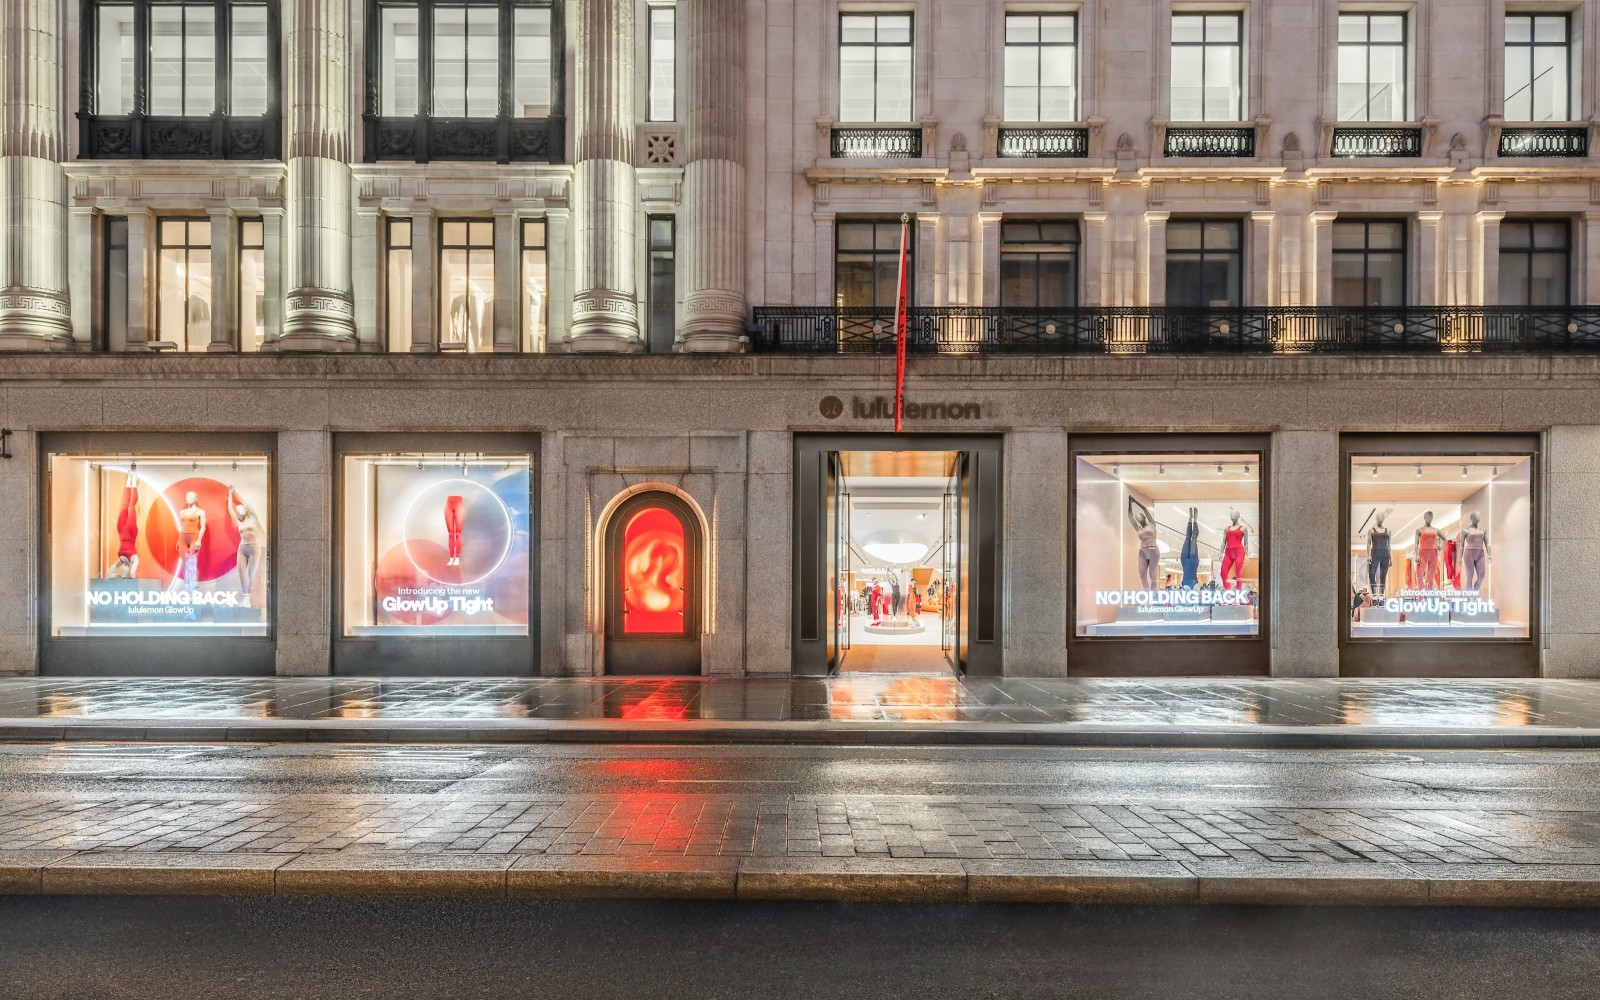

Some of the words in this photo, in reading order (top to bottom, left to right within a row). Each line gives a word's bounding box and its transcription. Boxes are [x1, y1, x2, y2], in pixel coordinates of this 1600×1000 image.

[398, 586, 446, 596] Introducing
[447, 587, 461, 595] the
[1401, 589, 1447, 597] Introducing
[87, 591, 113, 606] NO
[114, 591, 190, 606] HOLDING
[192, 591, 238, 606] BACK
[1095, 590, 1122, 605] NO
[1123, 590, 1200, 605] HOLDING
[1201, 590, 1249, 605] BACK
[128, 605, 164, 614] lululemon
[165, 605, 195, 615] GlowUp
[382, 596, 448, 614] GlowUp
[449, 596, 494, 614] Tight
[1137, 605, 1174, 613] lululemon
[1174, 605, 1204, 614] GlowUp
[1385, 597, 1450, 615] GlowUp
[1451, 597, 1495, 615] Tight
